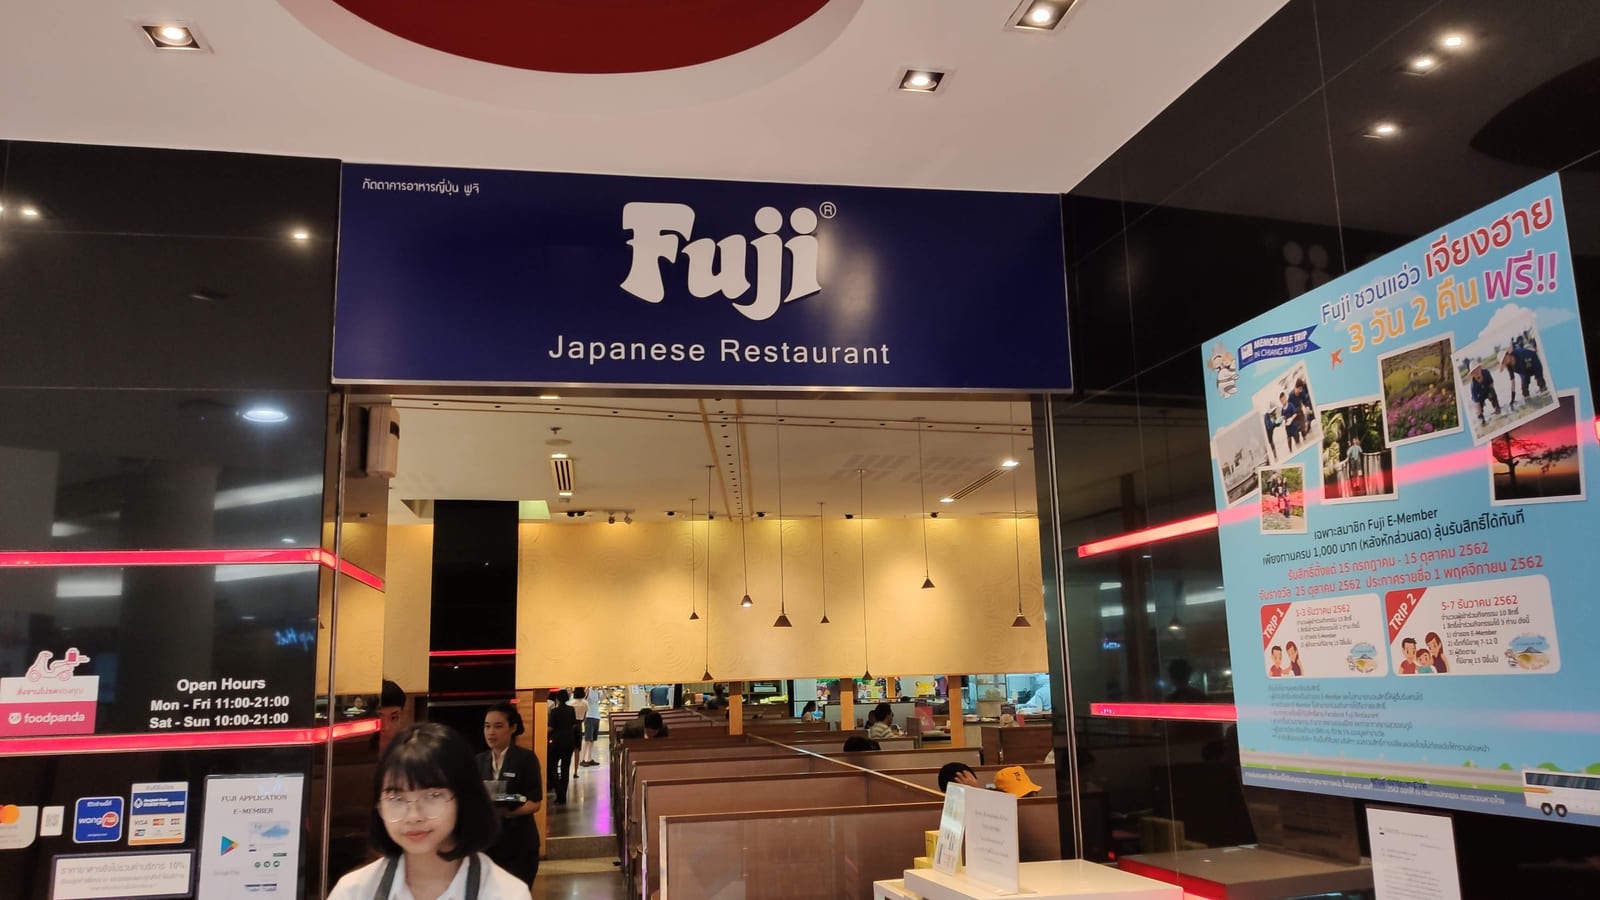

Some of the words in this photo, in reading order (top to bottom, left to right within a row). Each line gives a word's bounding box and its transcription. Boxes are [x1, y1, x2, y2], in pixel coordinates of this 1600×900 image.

[619, 201, 822, 321] Fuji
[1320, 299, 1351, 324] Fuji
[1424, 196, 1553, 279] เจียงฮาย
[1349, 324, 1364, 353] 3
[1371, 309, 1405, 346] วัน
[1411, 297, 1428, 328] 2
[1437, 277, 1479, 320] คืน
[548, 335, 706, 364] Japanese
[720, 338, 891, 365] Restaurant
[1368, 518, 1385, 533] Fuji
[1387, 508, 1438, 527] E-Member
[1313, 543, 1338, 559] 1,000
[1340, 541, 1358, 554] บาท
[1339, 563, 1350, 575] 15
[1404, 552, 1417, 565] 15
[1419, 547, 1456, 566] ตุลาคม
[1458, 541, 1489, 557] 2562
[1338, 578, 1361, 591] 2562
[1434, 569, 1441, 581] 1
[1510, 555, 1544, 571] 2562
[1389, 603, 1409, 632] TRIP
[1406, 592, 1417, 606] 2
[1441, 601, 1455, 611] 5-7
[1494, 595, 1519, 606] 2562
[1263, 615, 1279, 639] TRIP
[1276, 607, 1285, 618] 1
[176, 678, 218, 695] Open
[221, 676, 266, 691] Hours
[24, 711, 86, 726] foodpanda
[150, 699, 180, 712] Mon
[192, 698, 212, 711] Fri
[215, 695, 290, 710] 11:00-21:00
[149, 717, 173, 729] Sat
[183, 715, 211, 728] Sun
[214, 712, 290, 727] 10:00-21:00
